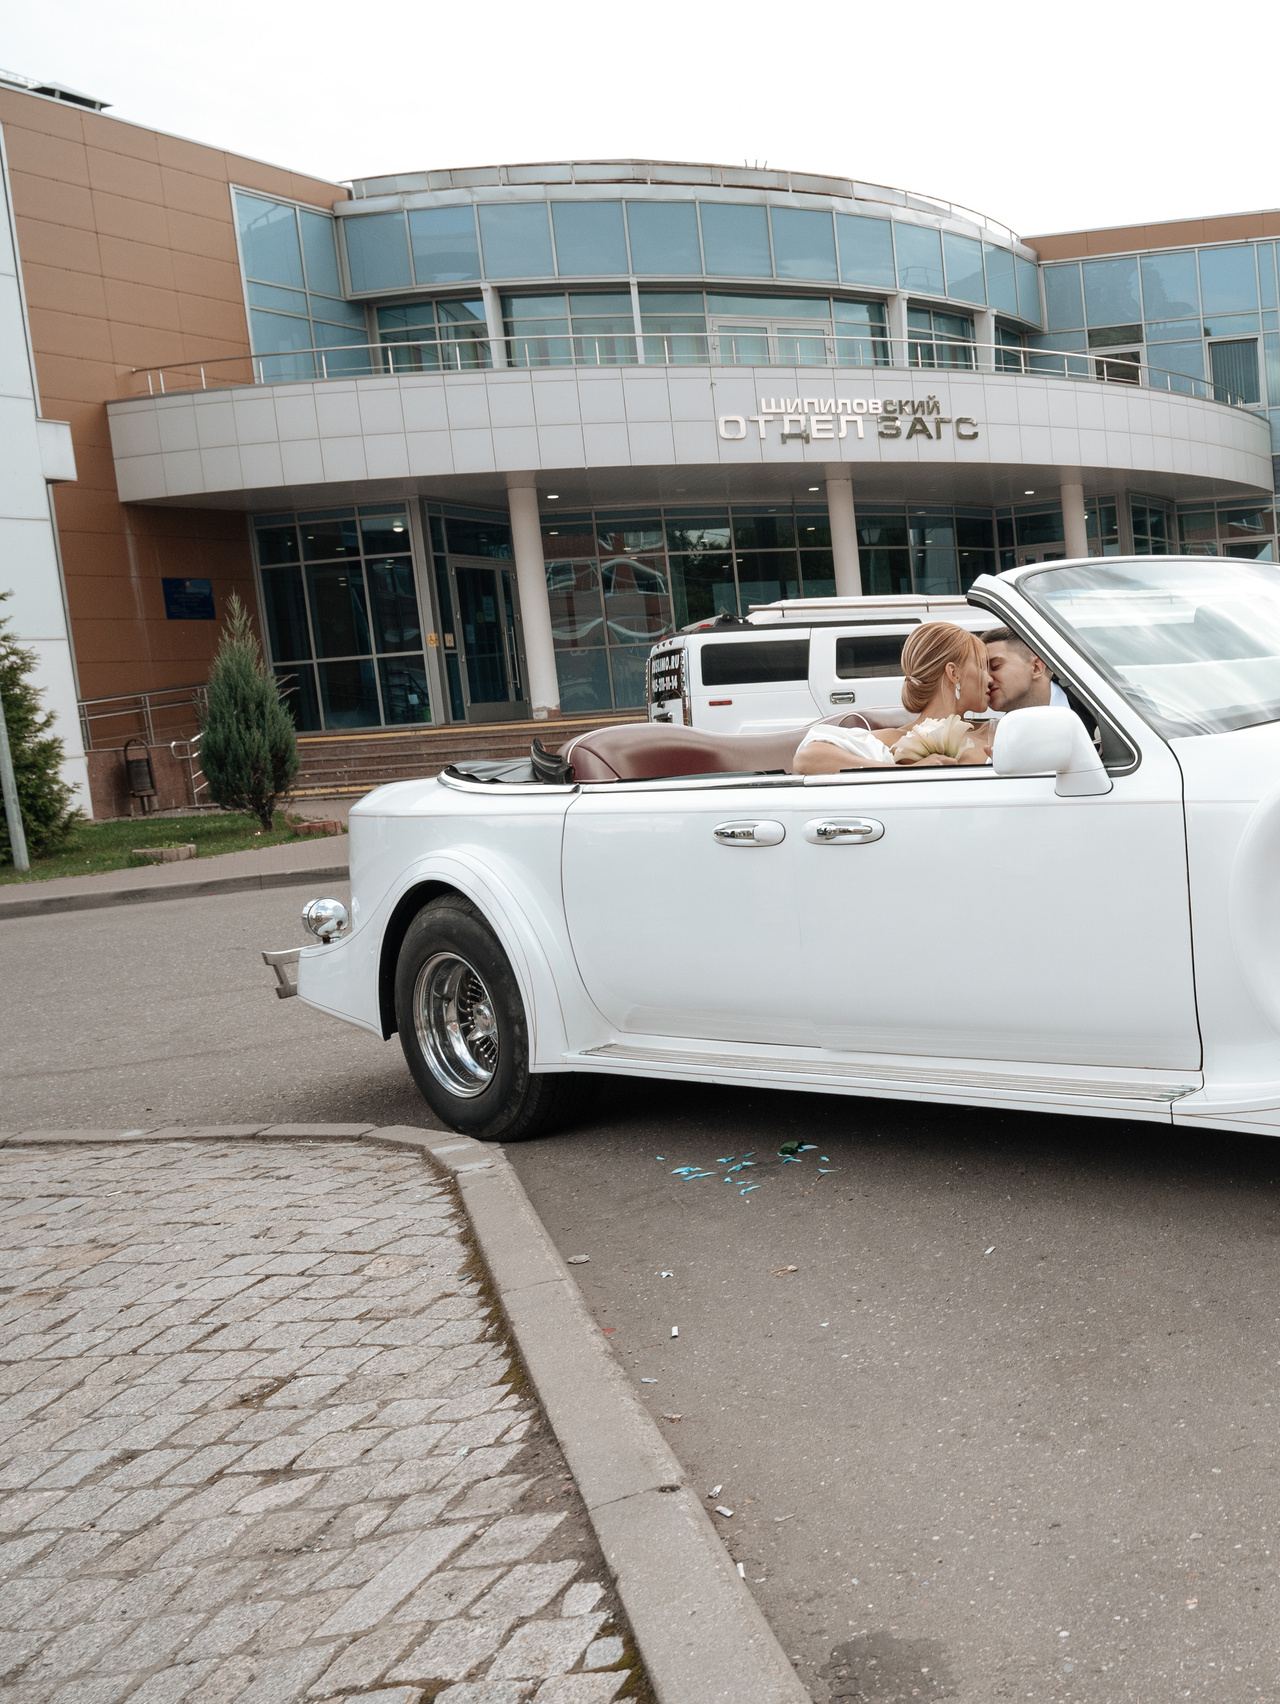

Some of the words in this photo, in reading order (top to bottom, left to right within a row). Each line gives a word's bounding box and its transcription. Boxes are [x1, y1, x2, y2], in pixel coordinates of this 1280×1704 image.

[760, 395, 941, 415] ШИПИЛОВСКИЙ
[718, 415, 865, 444] ОТДЕЛ
[877, 416, 979, 440] ЗАГС
